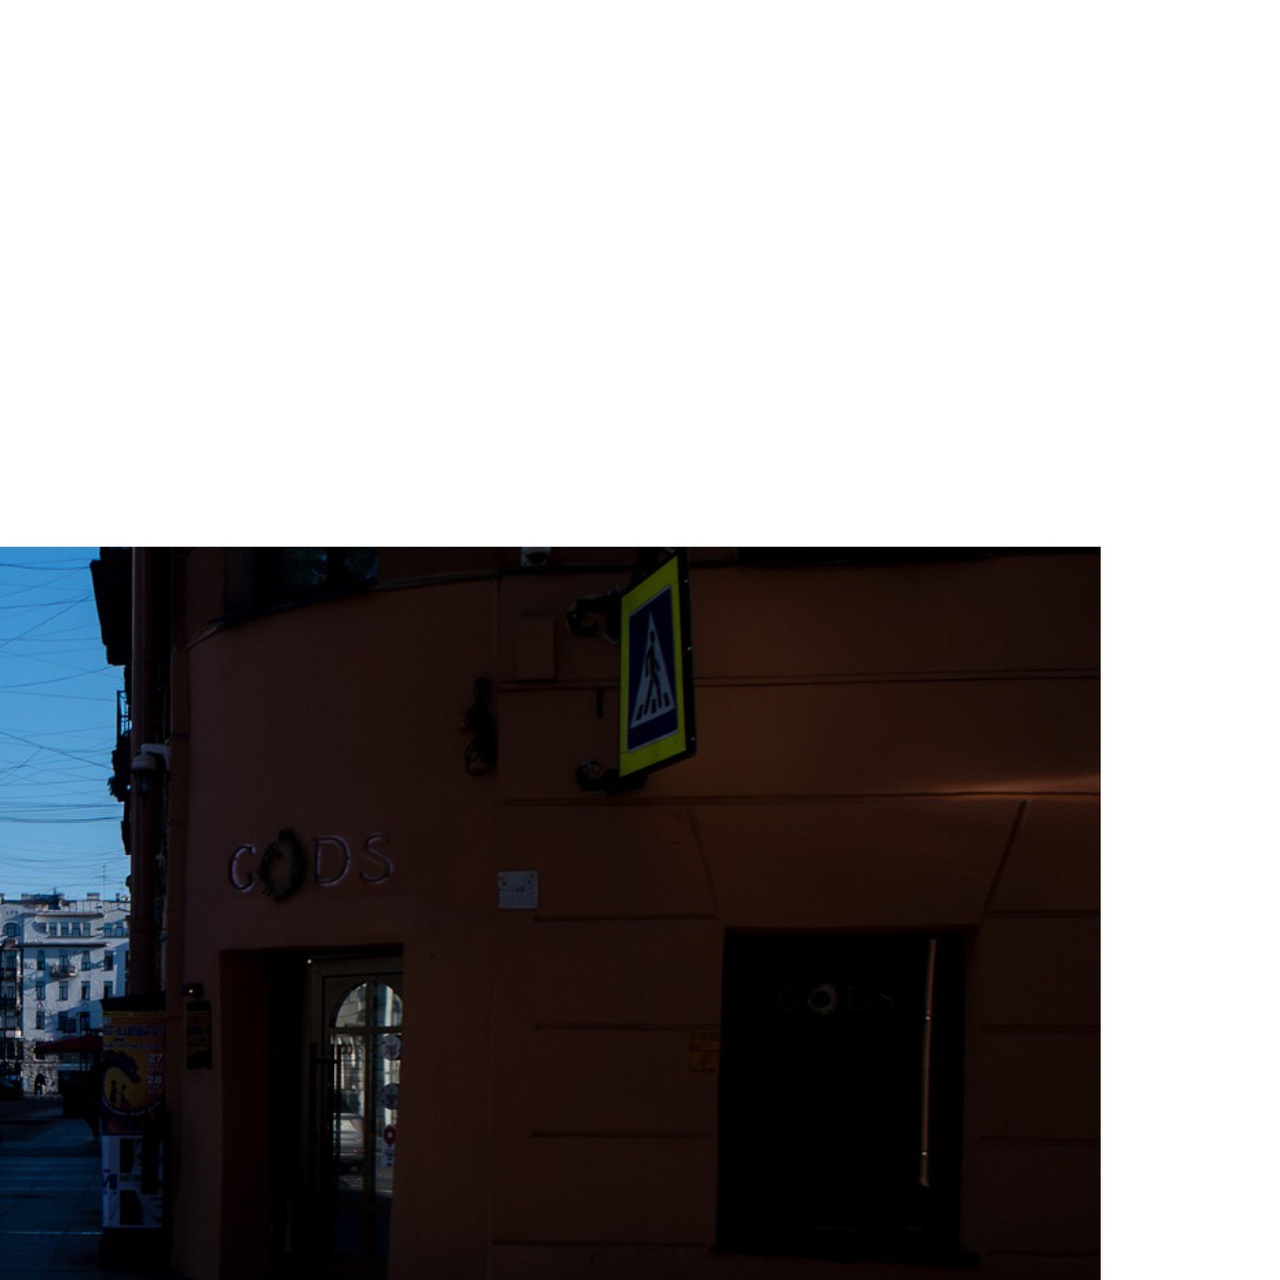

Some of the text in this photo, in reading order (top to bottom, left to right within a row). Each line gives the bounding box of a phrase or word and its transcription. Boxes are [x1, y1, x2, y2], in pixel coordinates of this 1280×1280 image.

[229, 829, 394, 903] GODS
[148, 1053, 163, 1063] 27
[147, 1075, 163, 1085] 28
